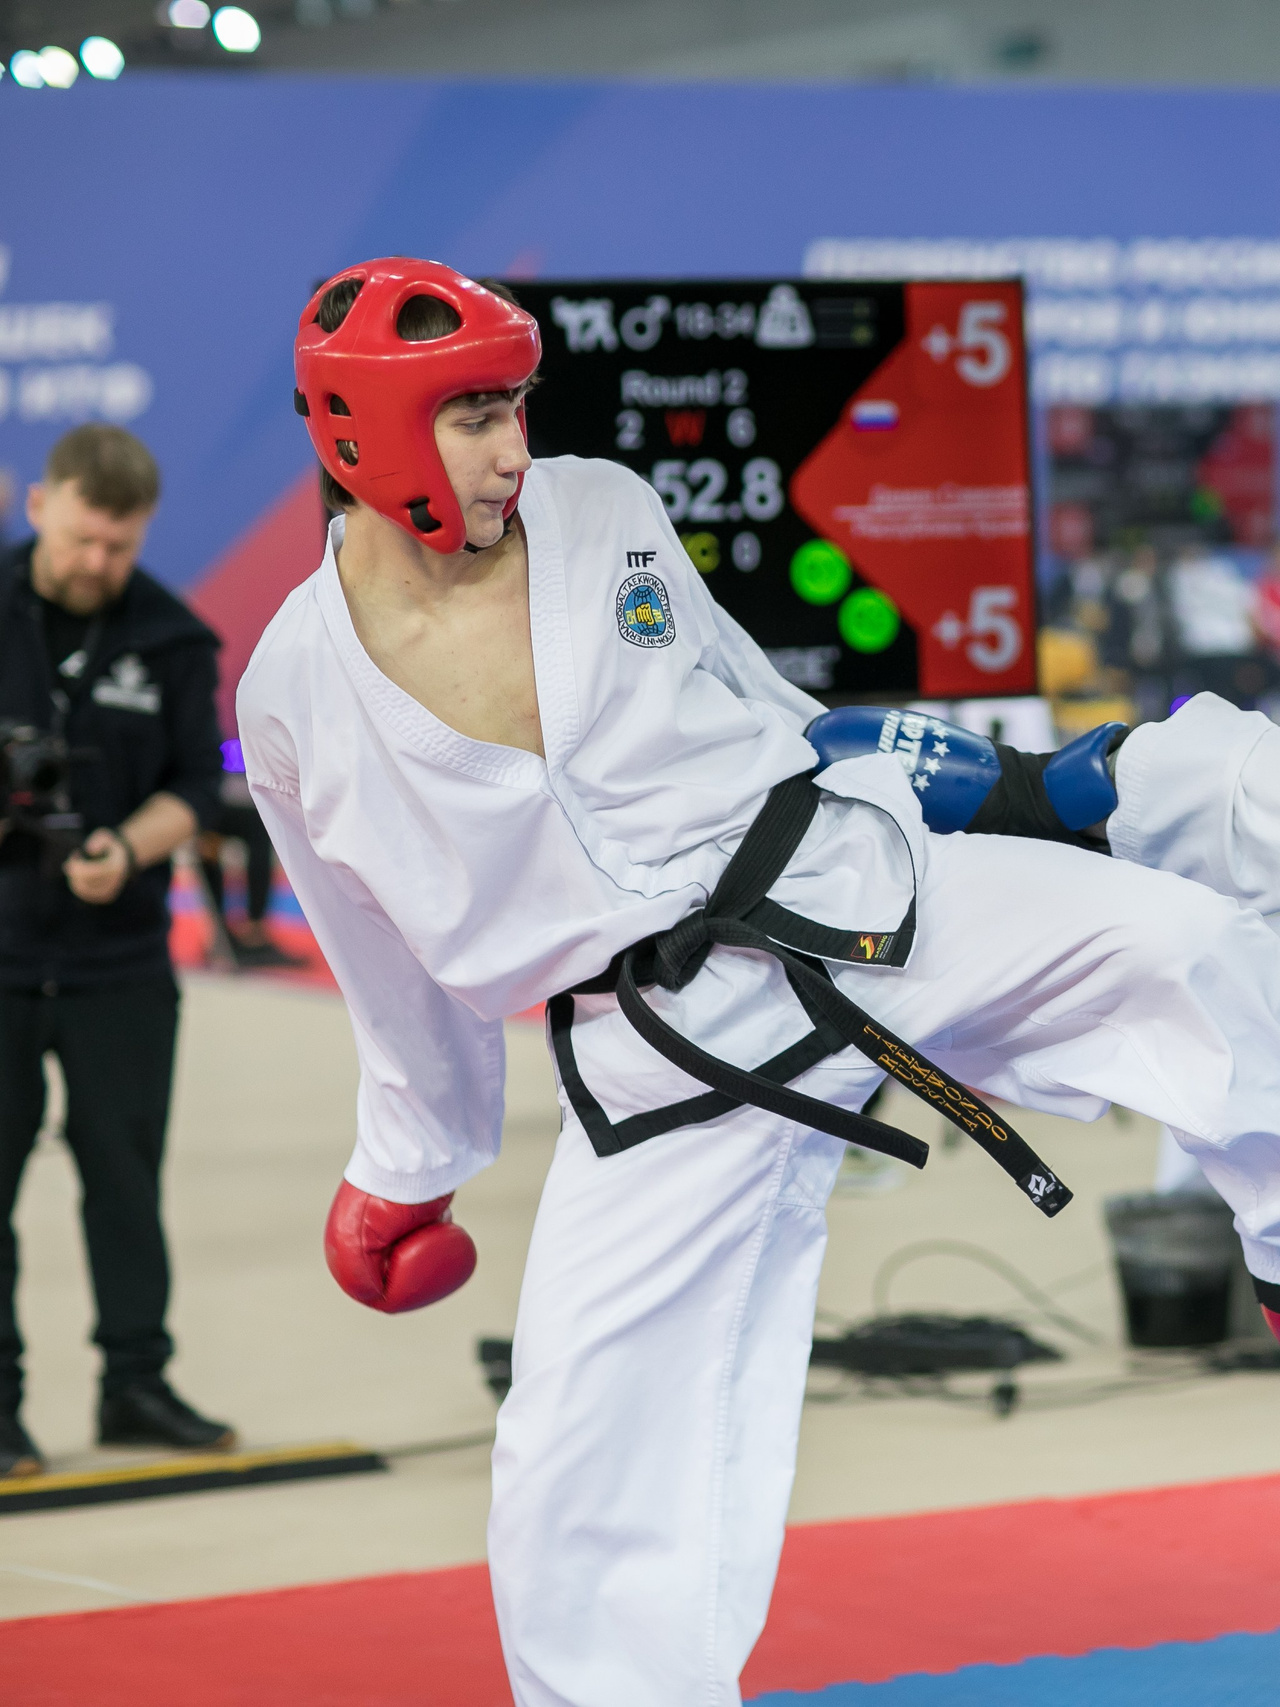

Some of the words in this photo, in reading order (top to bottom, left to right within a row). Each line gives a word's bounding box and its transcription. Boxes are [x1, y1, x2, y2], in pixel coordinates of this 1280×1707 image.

[921, 302, 1012, 386] +5
[621, 370, 721, 405] Round
[724, 368, 748, 405] 2
[616, 411, 644, 449] 2
[727, 409, 756, 448] 6
[626, 551, 657, 568] ITF
[930, 586, 1022, 672] +5
[863, 1024, 1008, 1141] TAEKWONDO
[878, 1053, 978, 1132] RUSSIA
